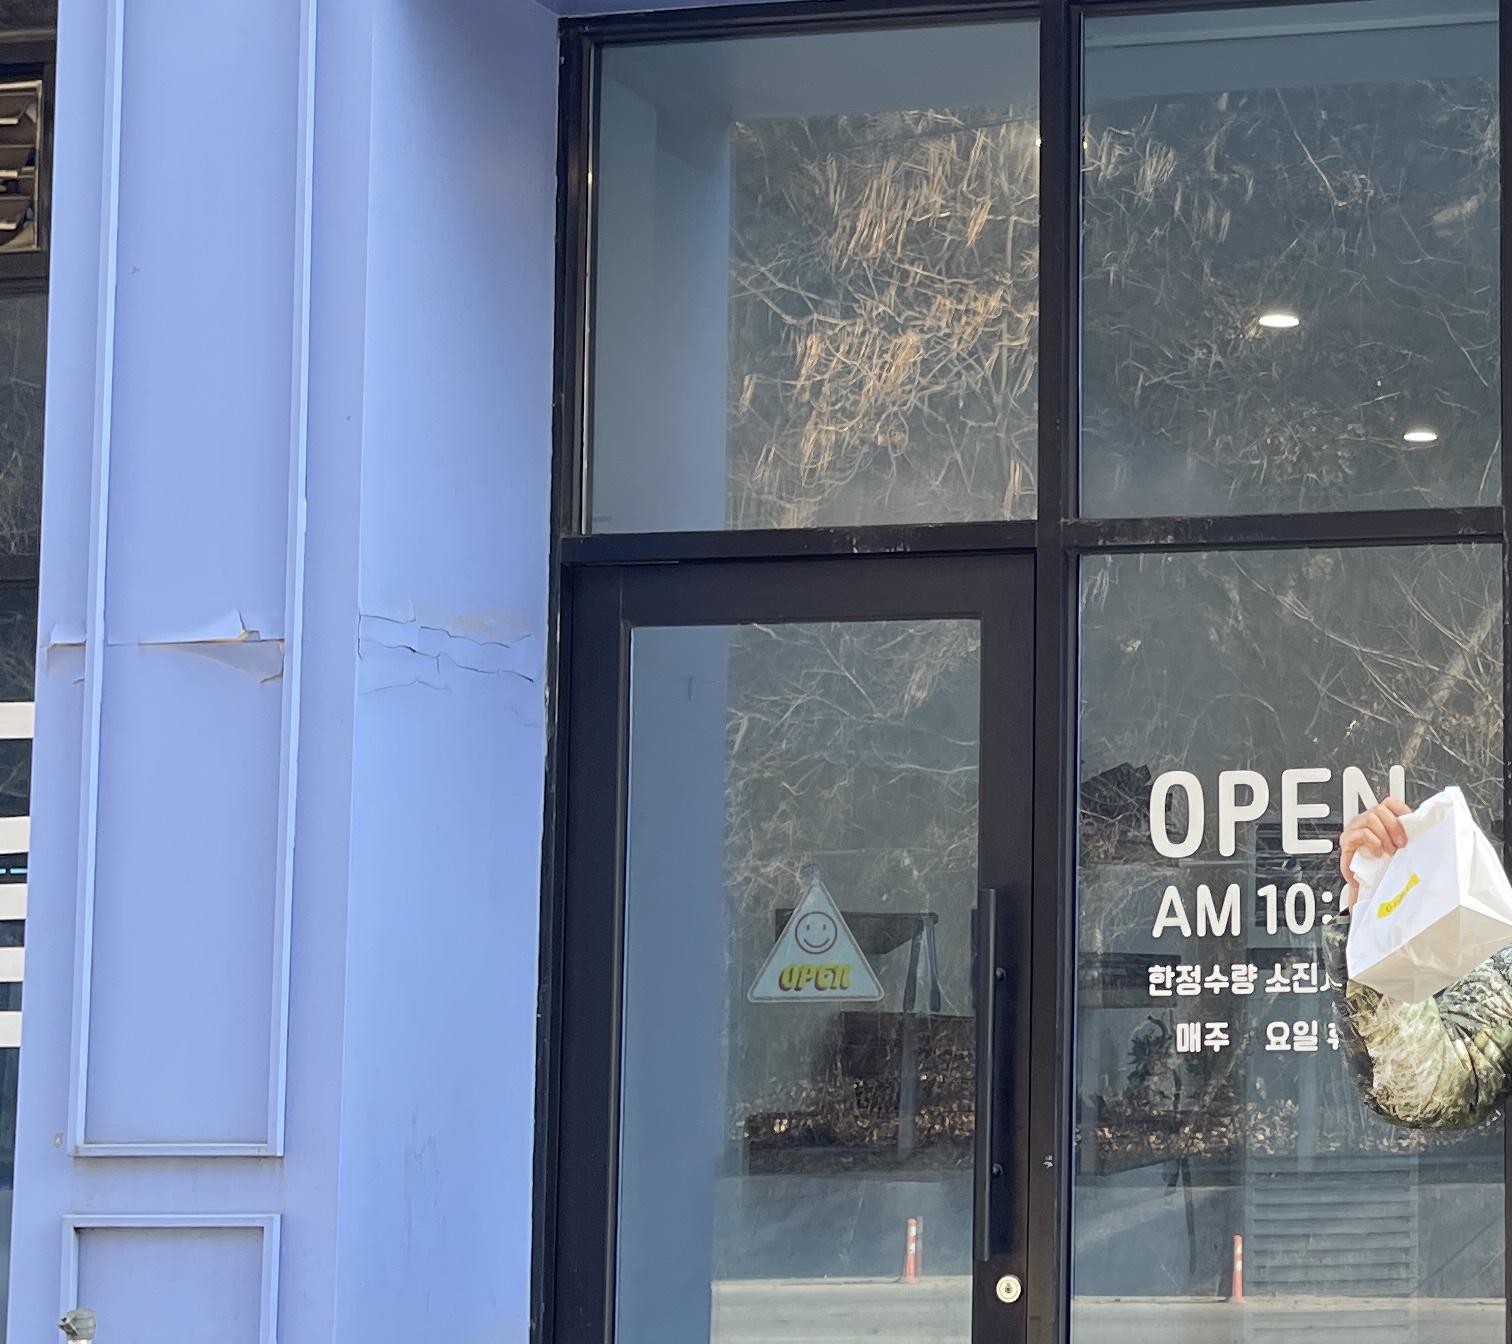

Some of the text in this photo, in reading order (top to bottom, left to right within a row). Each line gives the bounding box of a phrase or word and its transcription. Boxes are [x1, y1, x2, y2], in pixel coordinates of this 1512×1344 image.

[1152, 884, 1242, 938] AM
[1257, 882, 1350, 935] 10:
[1148, 964, 1258, 996] 한정수량
[1176, 1021, 1230, 1053] 매주
[1265, 1020, 1319, 1052] 요일
